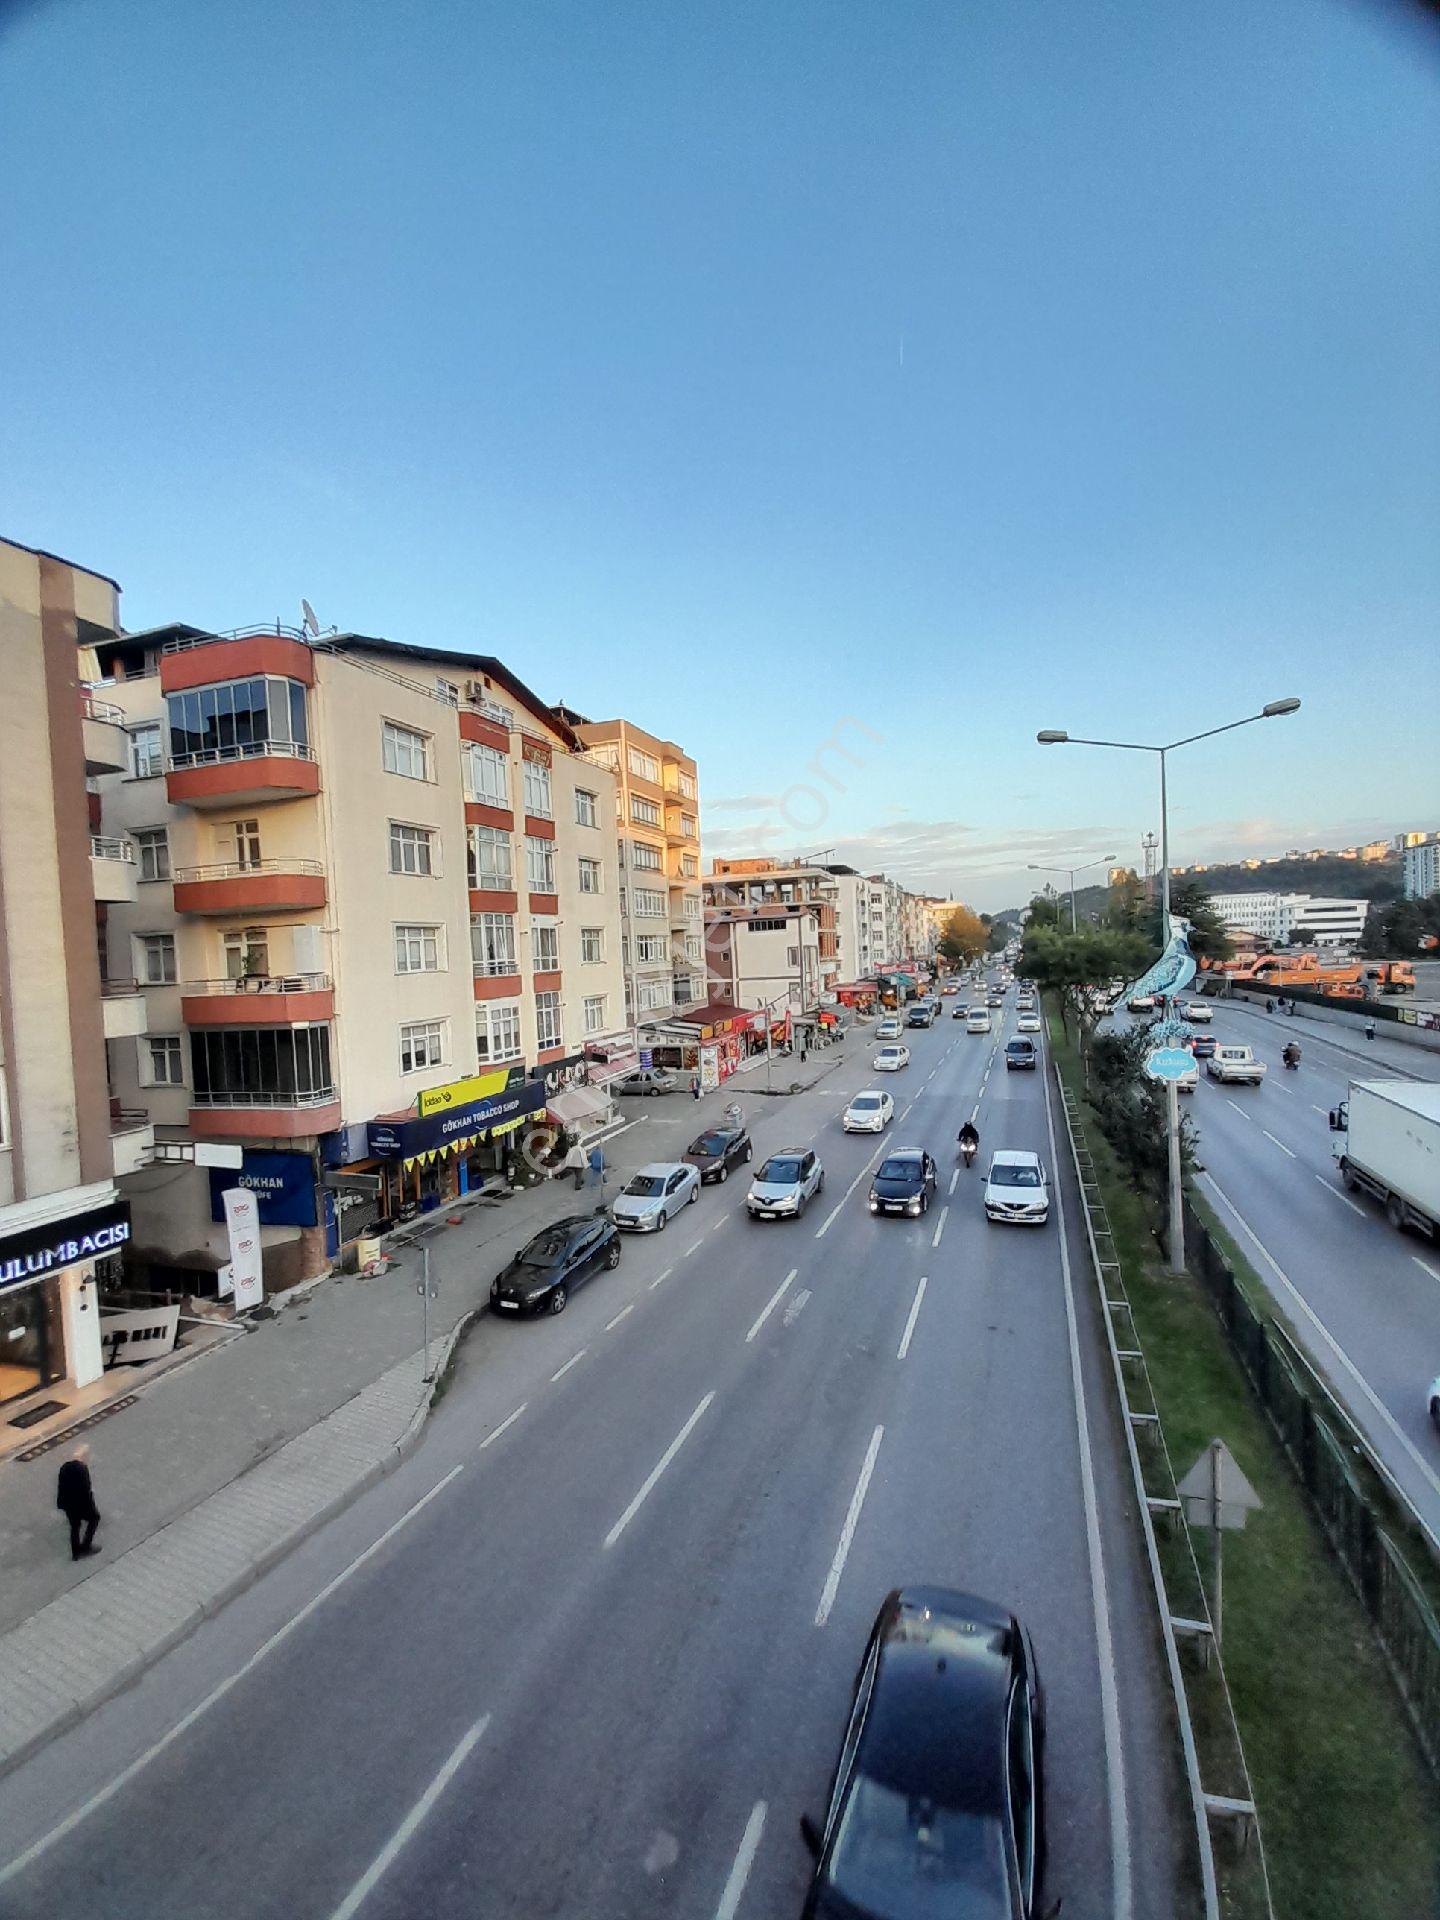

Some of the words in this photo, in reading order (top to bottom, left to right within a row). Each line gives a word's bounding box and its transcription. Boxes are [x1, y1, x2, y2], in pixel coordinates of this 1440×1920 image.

[442, 1115, 472, 1133] GÖKHAN
[473, 1104, 503, 1123] TOBACCO
[503, 1099, 520, 1113] SHOP
[238, 1174, 284, 1188] GÖKHAN
